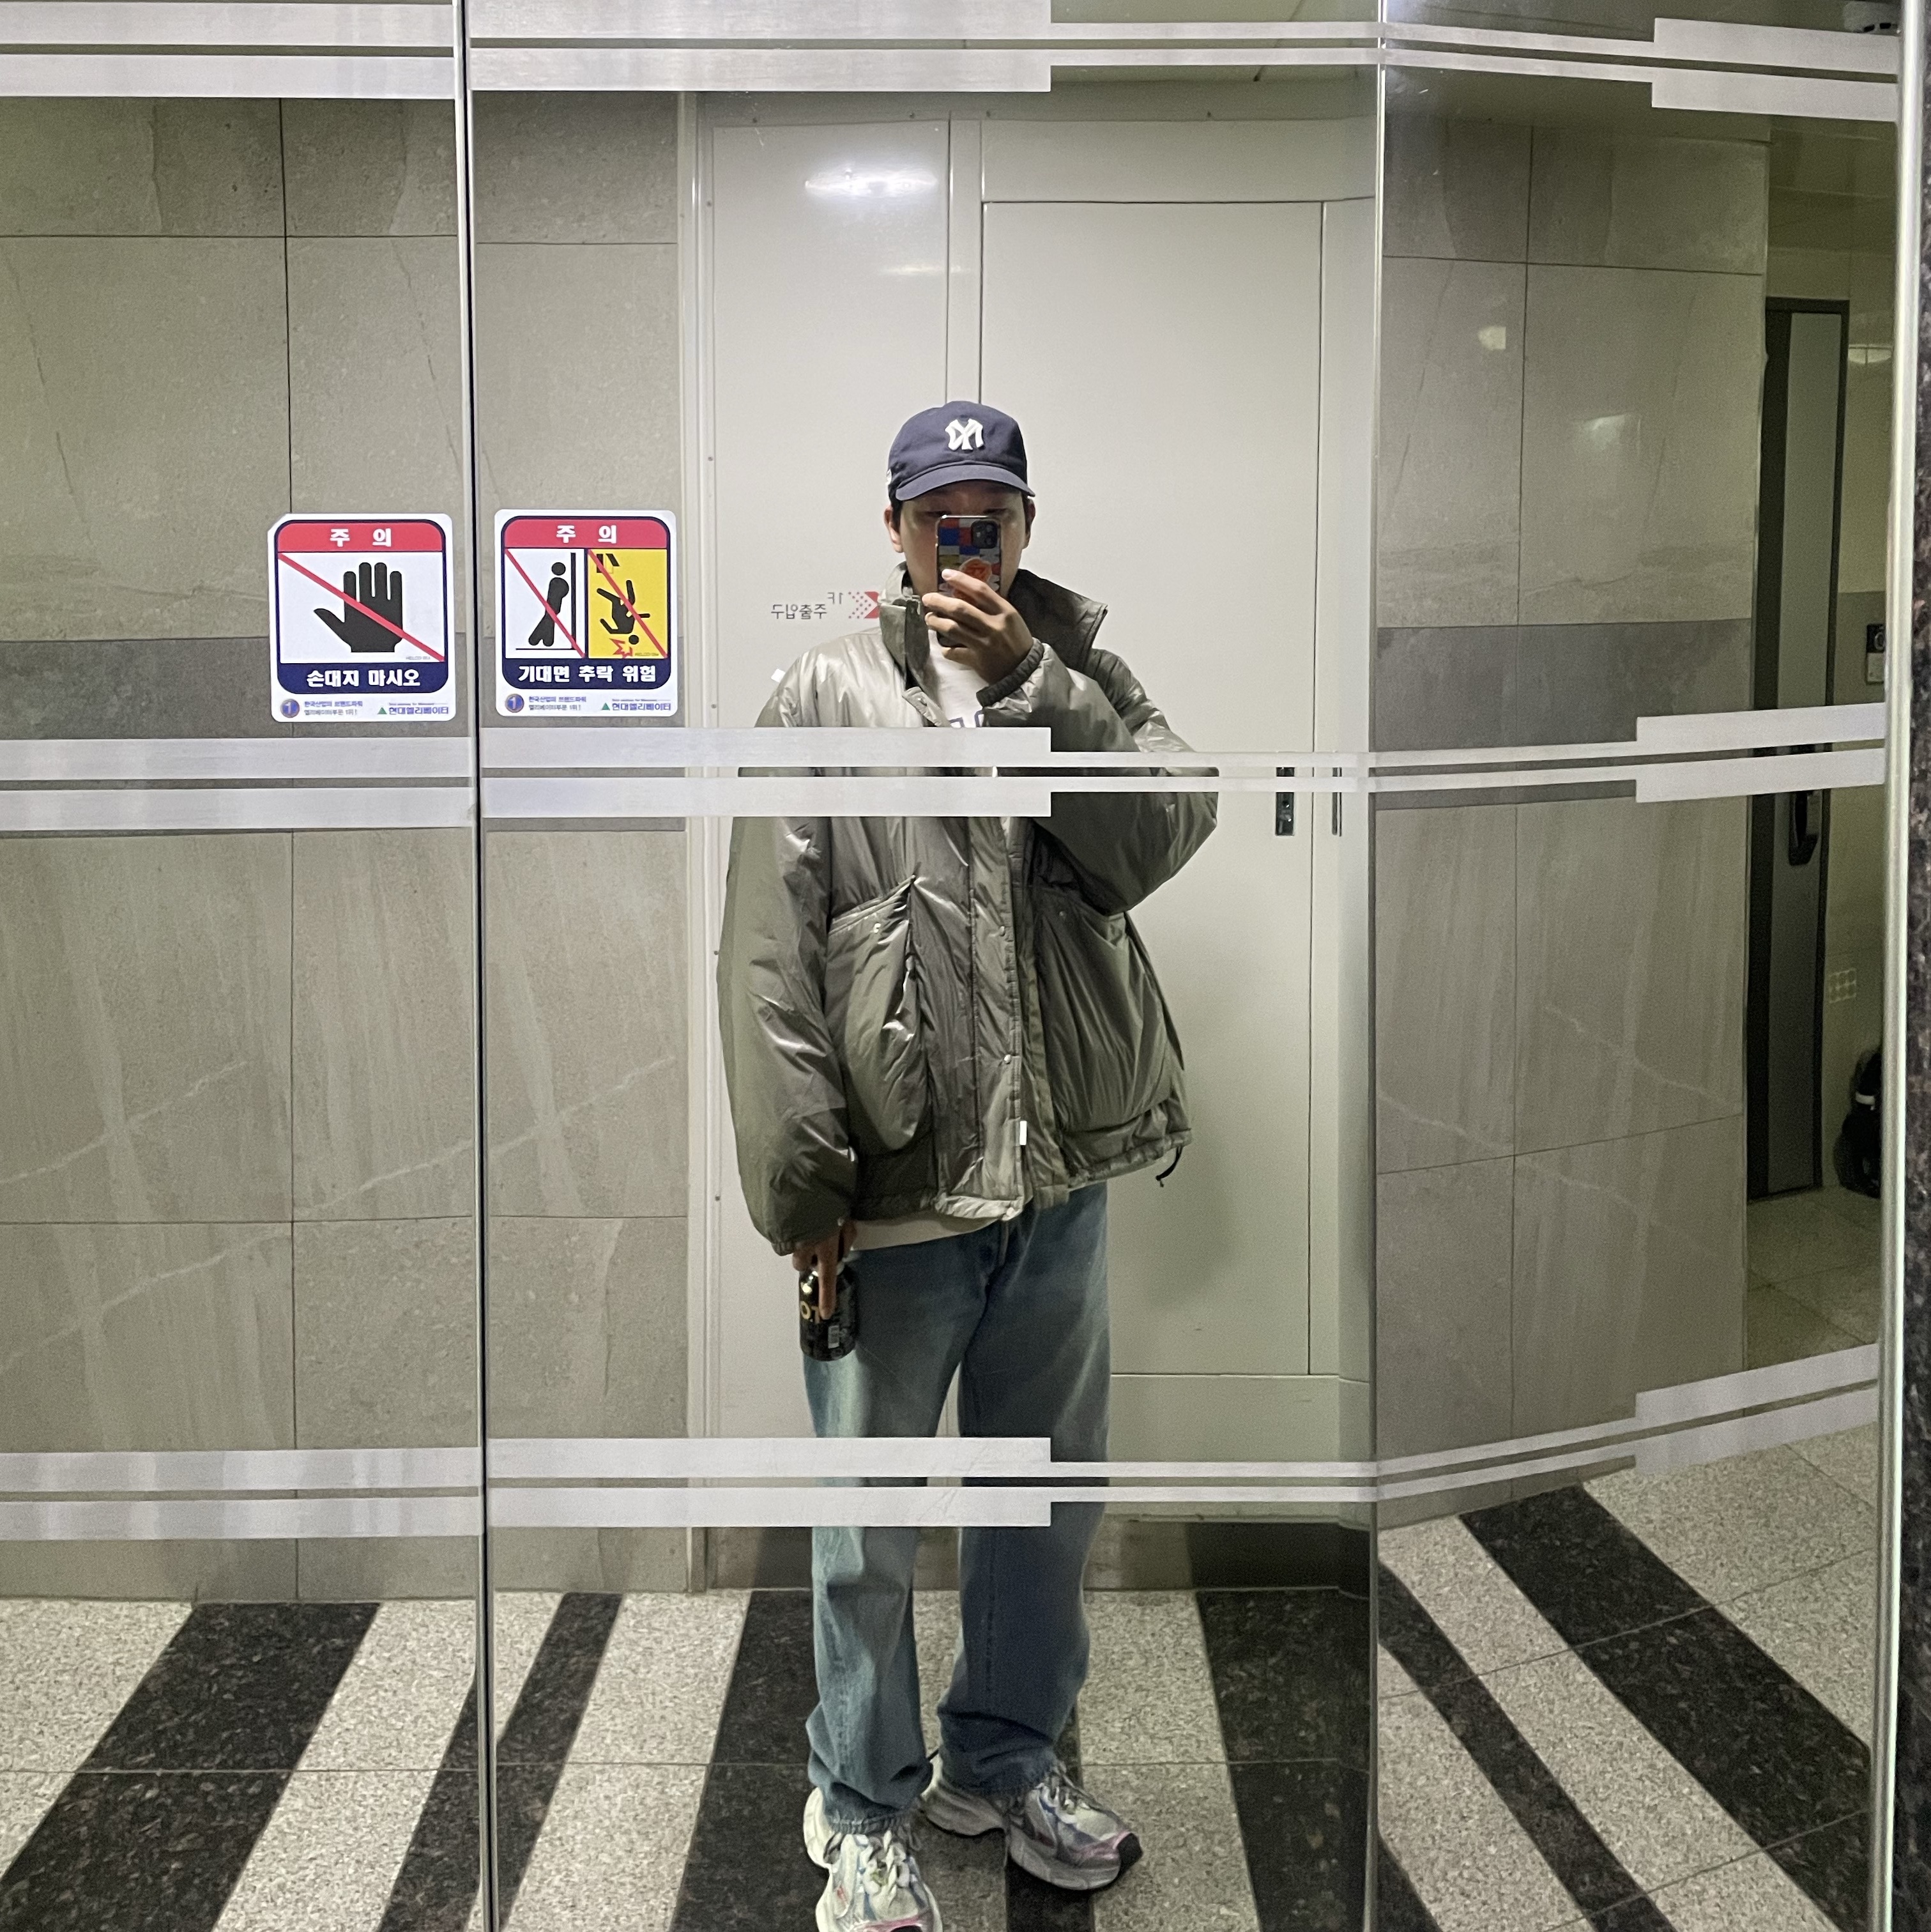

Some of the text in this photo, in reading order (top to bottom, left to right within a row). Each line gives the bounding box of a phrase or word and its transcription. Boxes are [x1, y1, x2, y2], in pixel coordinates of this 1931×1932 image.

[307, 669, 420, 687] 손대지 마시오
[518, 665, 656, 682] 기대면 추락 위험
[389, 707, 448, 715] 현대엘리베이터
